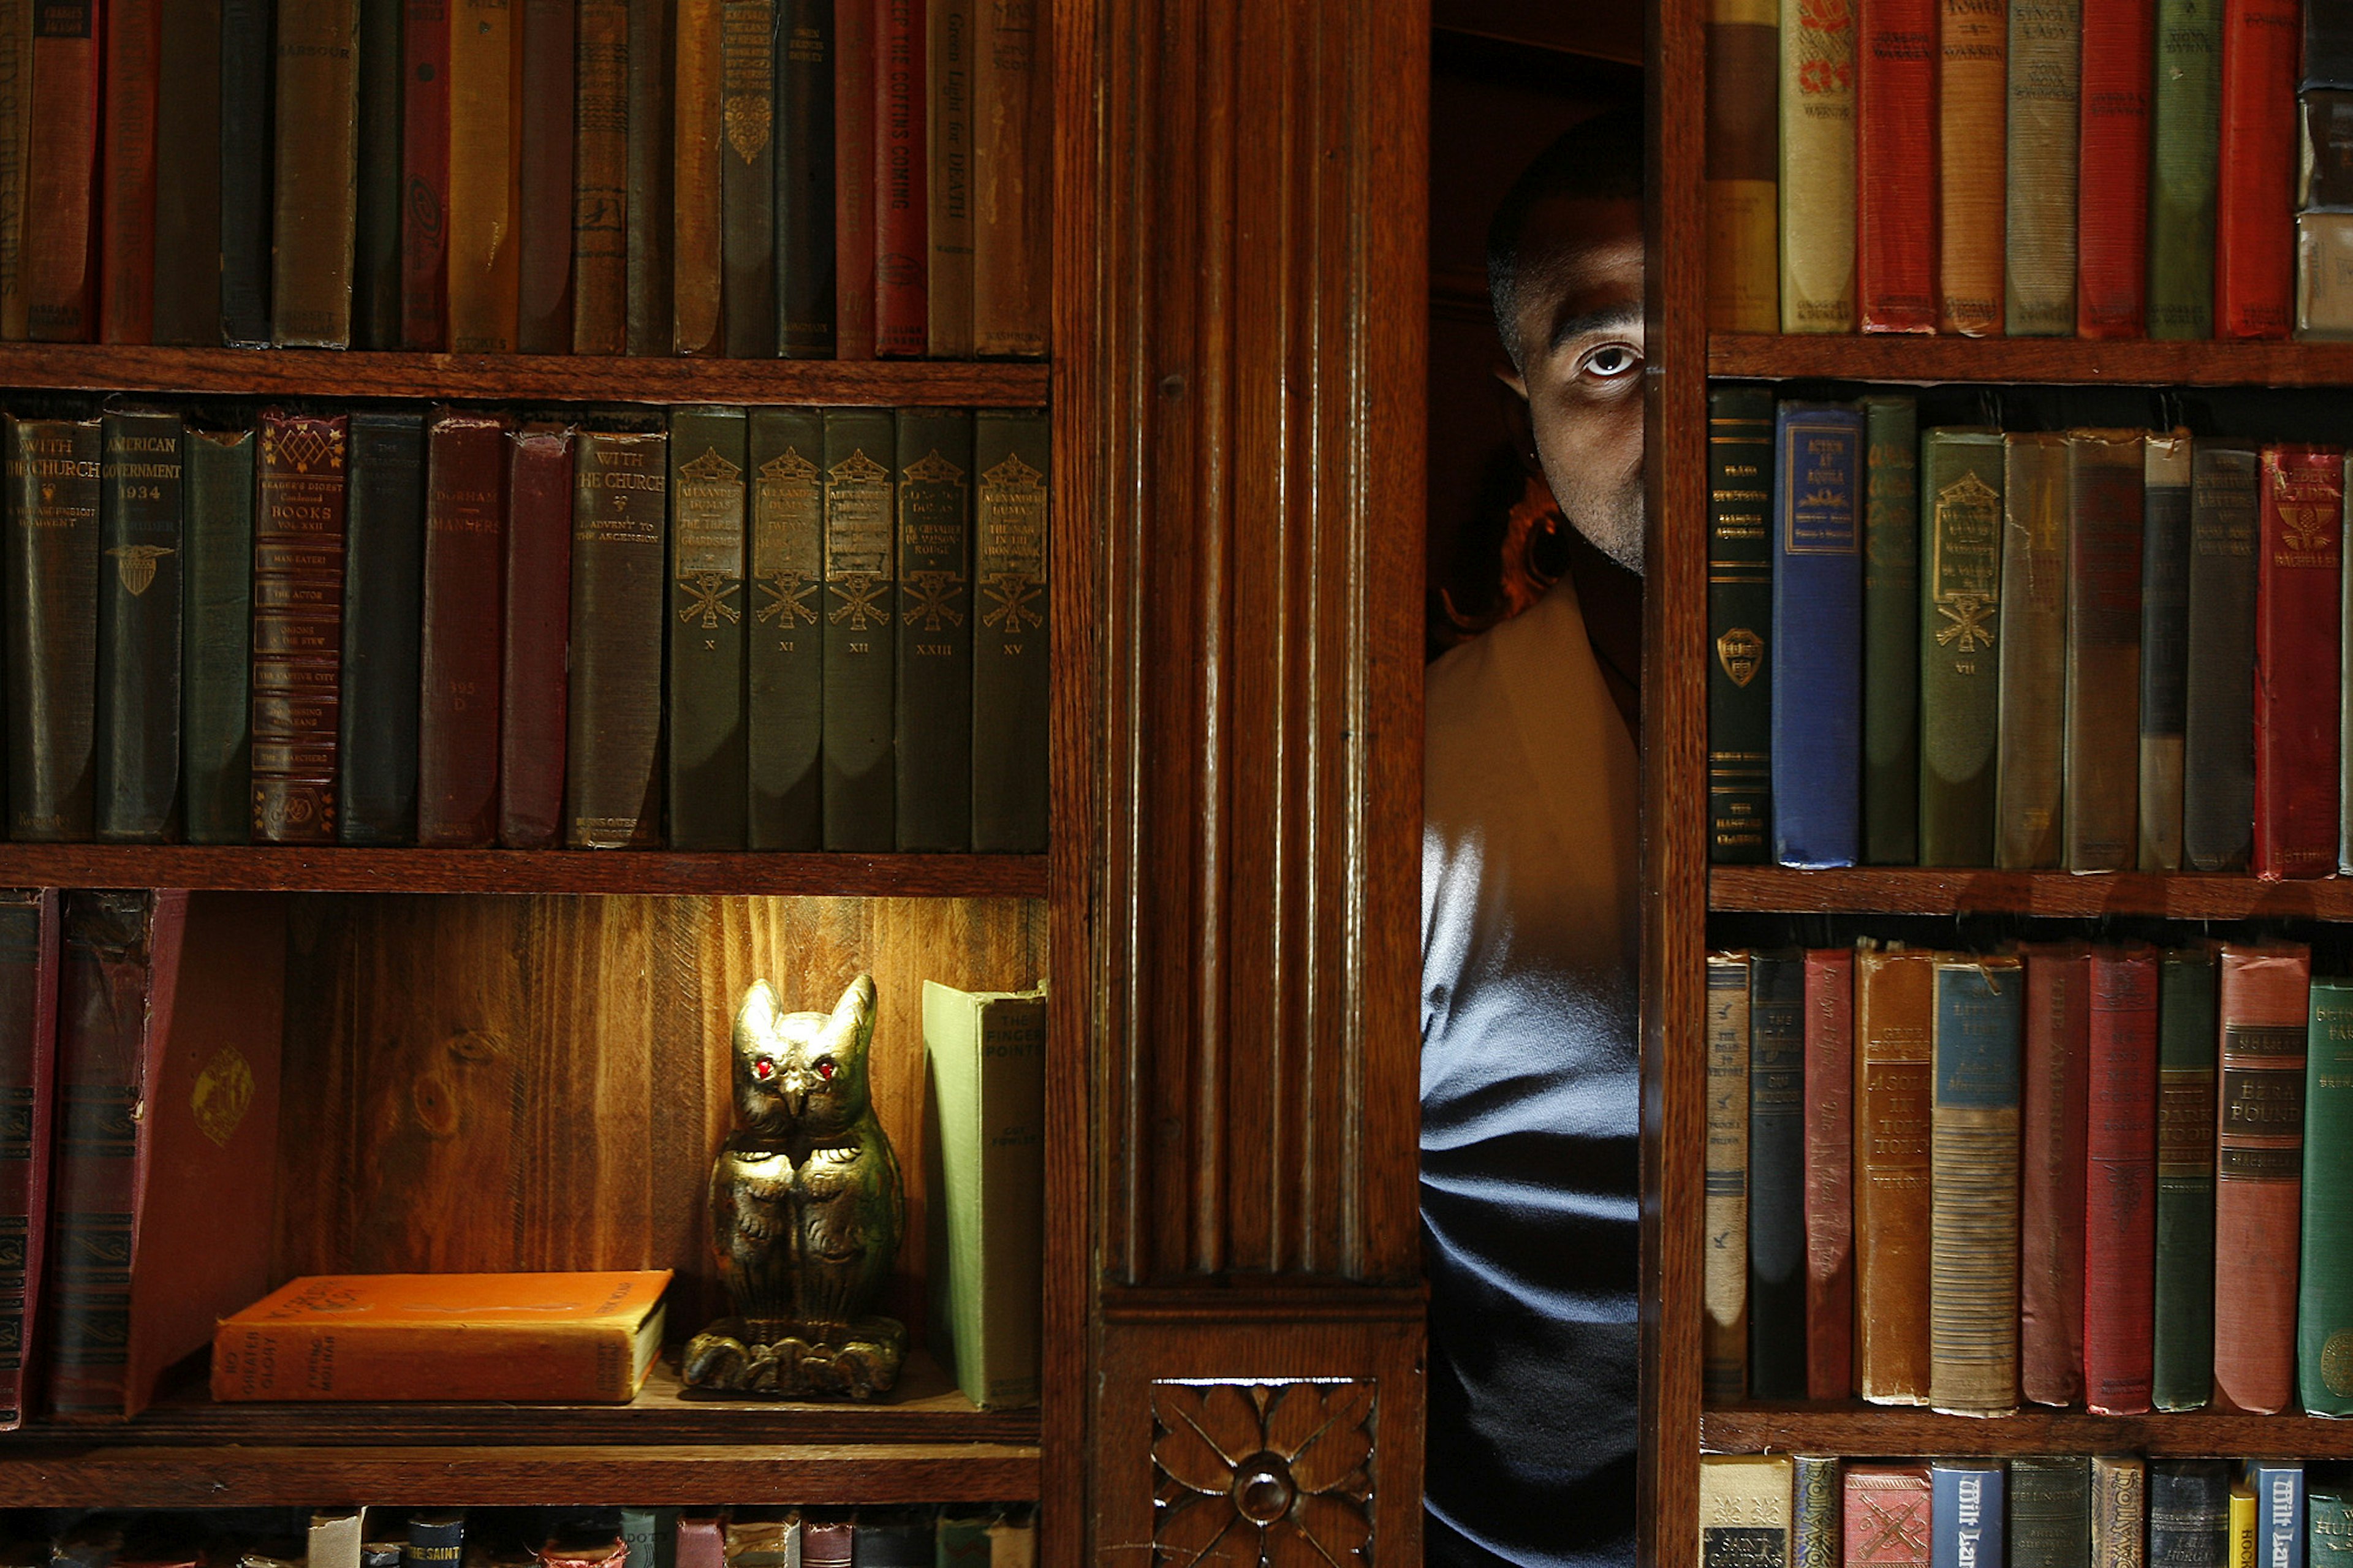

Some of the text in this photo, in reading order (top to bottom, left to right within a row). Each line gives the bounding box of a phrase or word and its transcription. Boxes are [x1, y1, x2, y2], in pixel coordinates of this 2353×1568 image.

[2016, 7, 2078, 22] SINGLE
[2024, 25, 2069, 40] LADY
[4, 32, 19, 85] CITY
[2, 96, 19, 126] OF
[944, 13, 966, 219] Green Light for DEATH
[892, 35, 909, 210] THE COFFINS COMING
[2, 137, 19, 184] THE
[21, 439, 73, 453] WITH
[106, 437, 176, 453] AMERICAN
[596, 452, 645, 467] WITH
[32, 460, 100, 479] CHURCH
[102, 463, 181, 479] GOVERNMENT
[2293, 468, 2330, 483] EBEN
[308, 482, 343, 492] DIGEST
[605, 473, 664, 493] CHURCH
[119, 486, 161, 499] 1934
[690, 500, 730, 510] DUMAS
[271, 506, 332, 520] BOOKS
[432, 518, 501, 534] MANNERS
[590, 520, 654, 531] ADVENT TO
[681, 519, 700, 529] THE
[576, 532, 659, 545] THE ASCENSION
[914, 545, 950, 555] ROUGE
[2274, 551, 2341, 567] BACHELLER
[704, 640, 716, 650] X
[779, 640, 794, 652] XI
[848, 643, 869, 654] XII
[916, 644, 952, 655] XXIII
[1002, 645, 1023, 655] XV
[315, 673, 335, 681] CITY
[607, 817, 637, 828] OATES
[1002, 1015, 1029, 1026] THE
[1768, 1015, 1793, 1025] THE
[987, 1029, 1042, 1042] FINGER
[1883, 1027, 1923, 1040] GENE
[986, 1045, 1043, 1058] POINTS
[2107, 1050, 2138, 1062] AND
[2048, 979, 2065, 1191] THE AMERICAN
[2241, 1080, 2296, 1100] EZRA
[1889, 1097, 1916, 1113] IN
[2230, 1100, 2300, 1123] POUND
[1821, 1101, 1837, 1131] The
[2160, 1108, 2213, 1123] DARK
[1873, 1138, 1929, 1154] TOMS
[225, 1352, 238, 1374] NO
[243, 1331, 259, 1395] GREATER
[262, 1338, 276, 1390] GLORY
[322, 1336, 335, 1392] MOLNAR
[1960, 1480, 1980, 1526] Milt
[2272, 1480, 2293, 1526] Milt
[426, 1547, 460, 1560] SAINT
